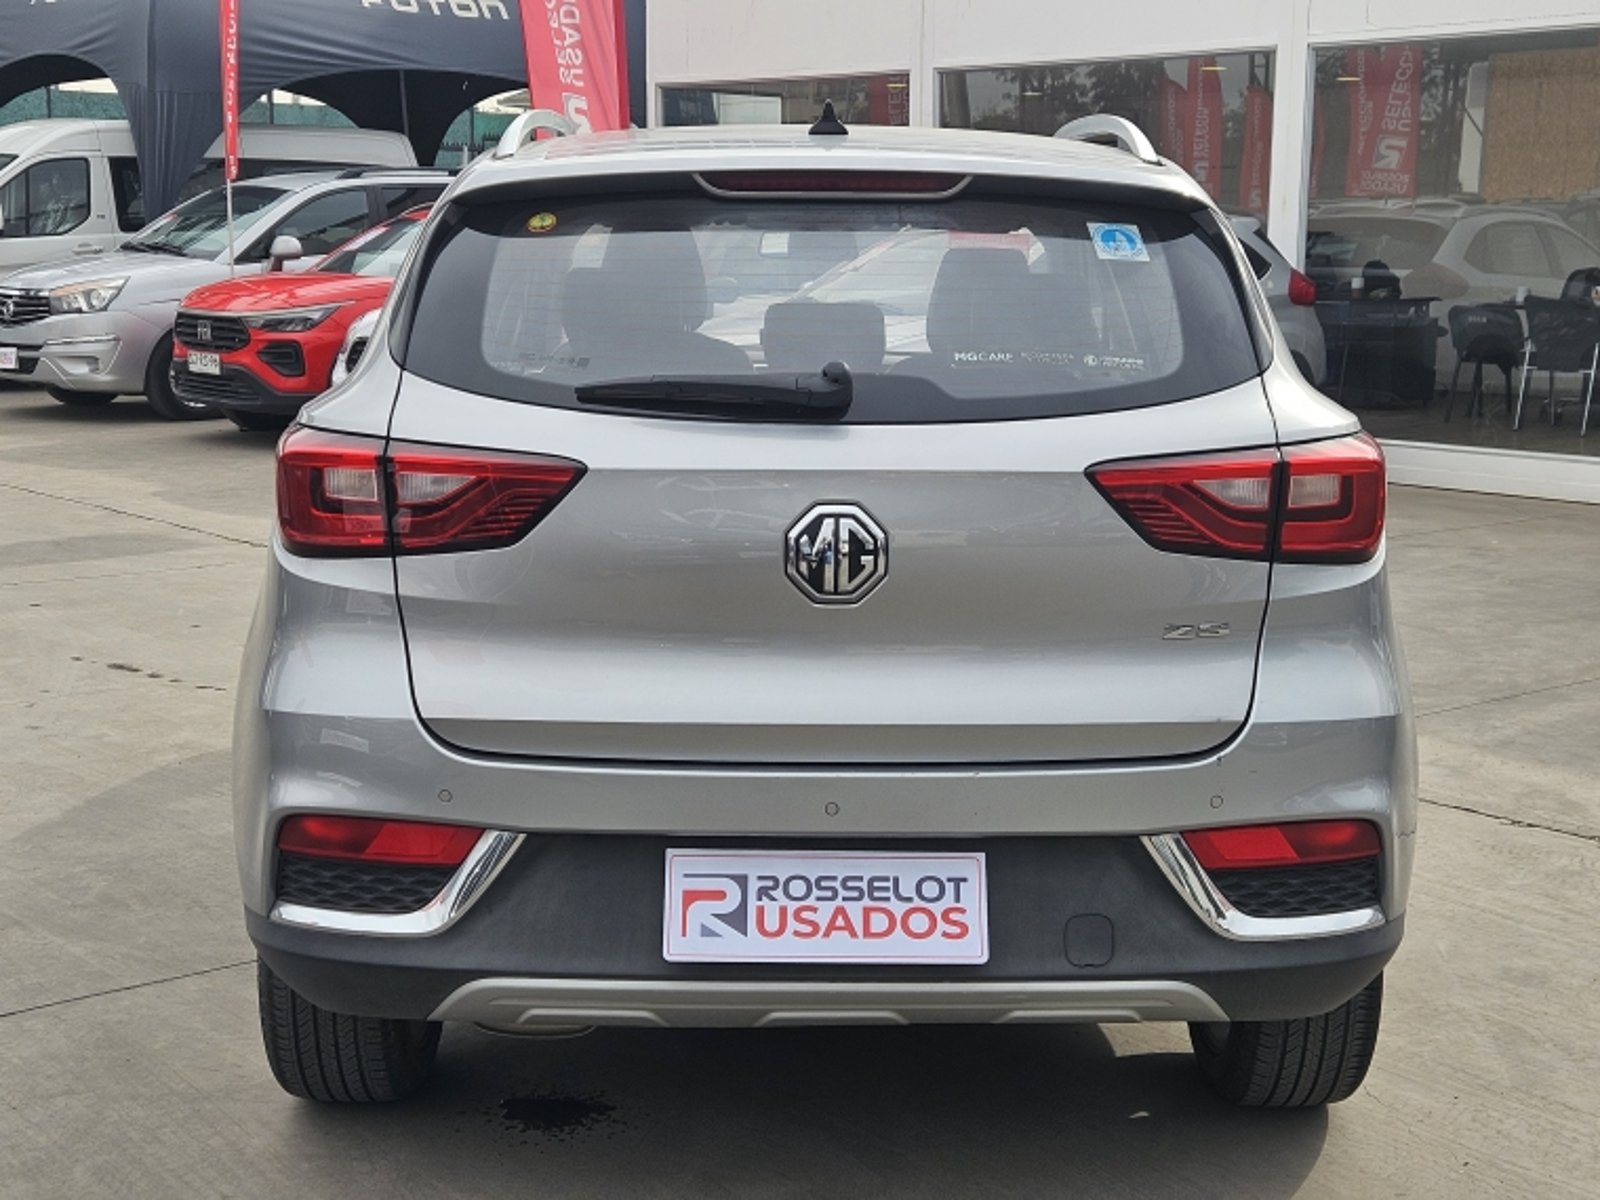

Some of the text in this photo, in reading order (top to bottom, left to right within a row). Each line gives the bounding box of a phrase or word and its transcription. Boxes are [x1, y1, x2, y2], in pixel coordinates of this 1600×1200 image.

[797, 515, 876, 595] MG
[1162, 621, 1230, 640] ZS
[756, 875, 968, 903] ROSSELOT
[755, 905, 970, 939] USADOS
